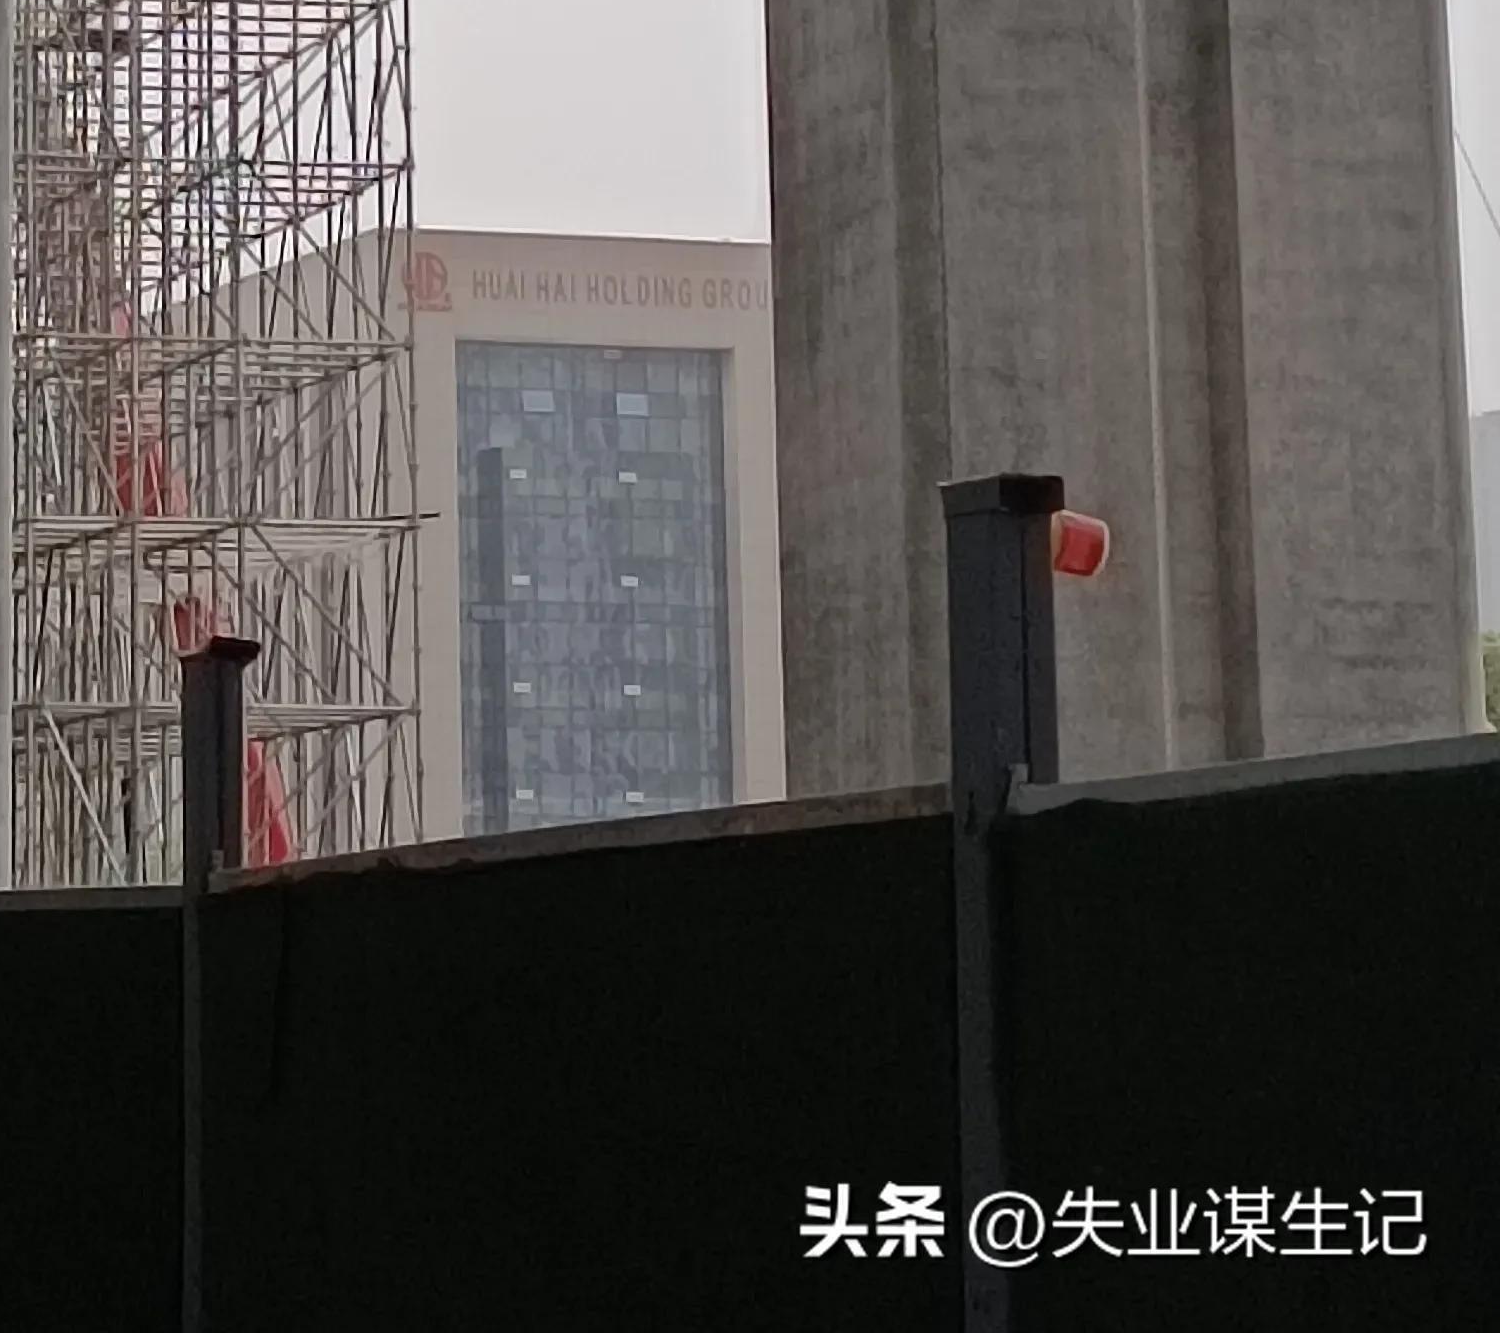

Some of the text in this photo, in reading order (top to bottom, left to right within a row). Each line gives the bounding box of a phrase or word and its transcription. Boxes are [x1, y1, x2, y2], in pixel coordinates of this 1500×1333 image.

[472, 268, 526, 301] HUAI
[536, 271, 577, 303] HAI
[587, 272, 693, 309] HOLDING
